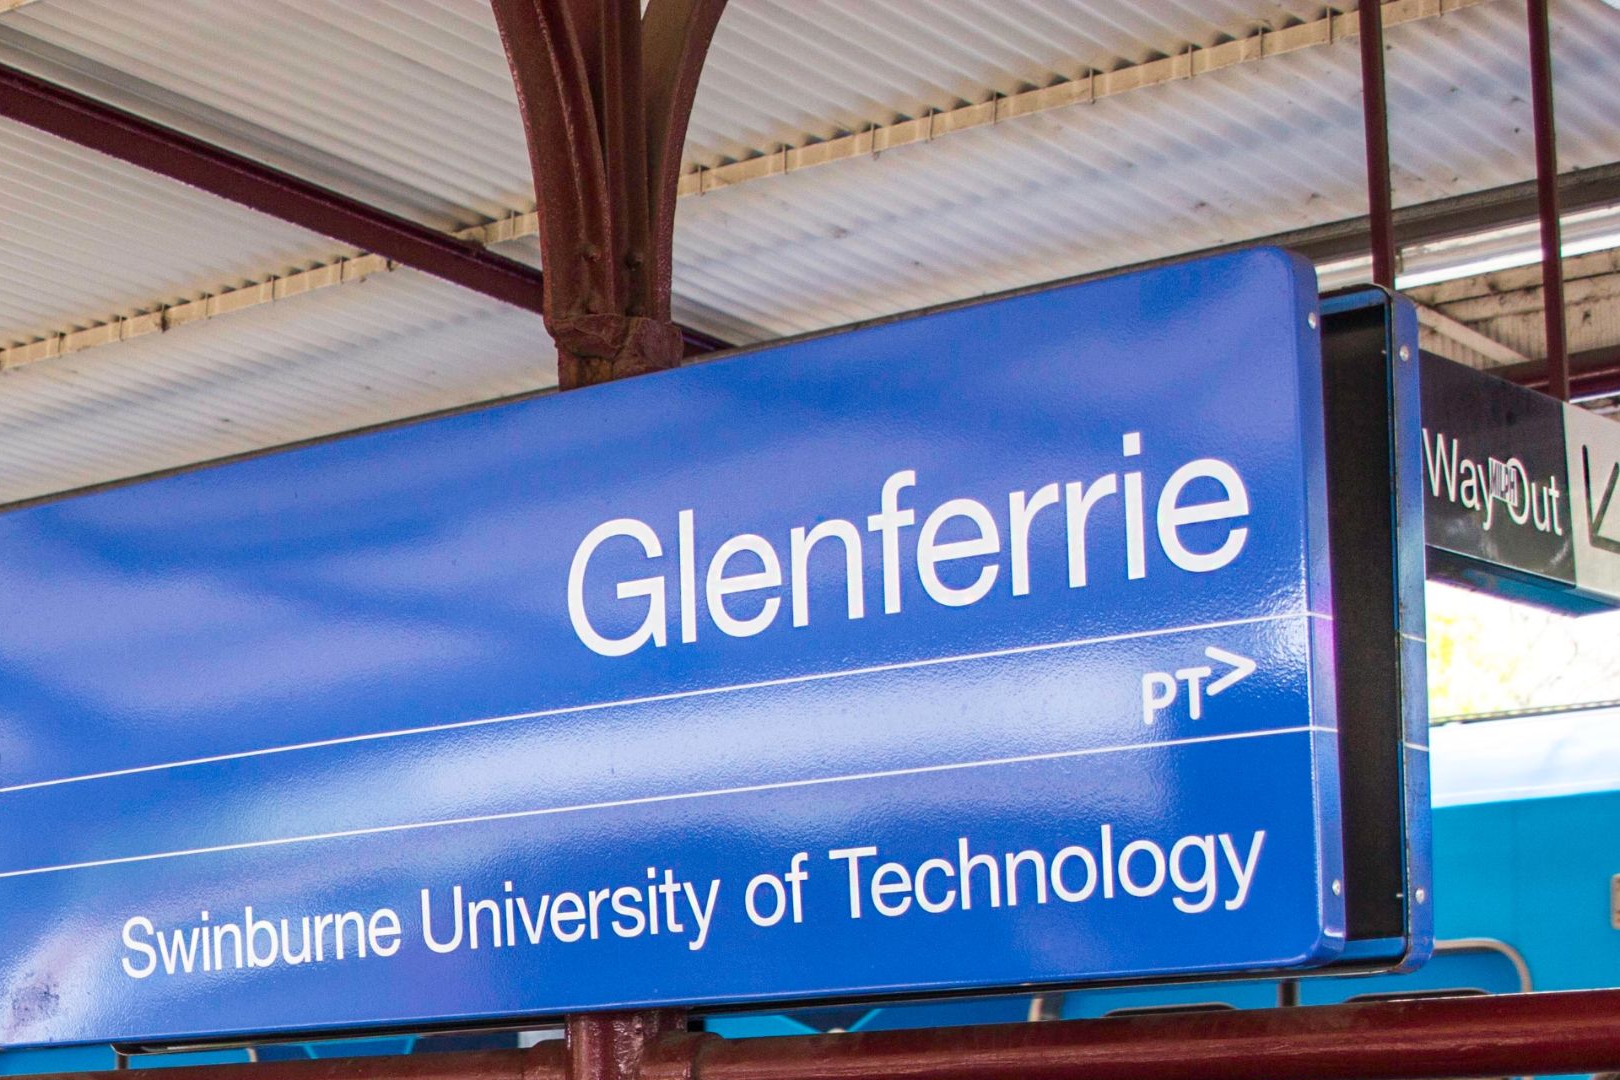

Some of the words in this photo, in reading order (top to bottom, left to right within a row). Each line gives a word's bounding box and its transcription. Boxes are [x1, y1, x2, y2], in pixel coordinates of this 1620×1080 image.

[566, 430, 1250, 658] Glenferrie
[1422, 428, 1493, 531] Way
[1506, 457, 1563, 536] Out
[121, 907, 402, 980] Swinburne
[421, 867, 721, 951] University
[744, 852, 809, 928] of
[829, 824, 1266, 914] Technology
